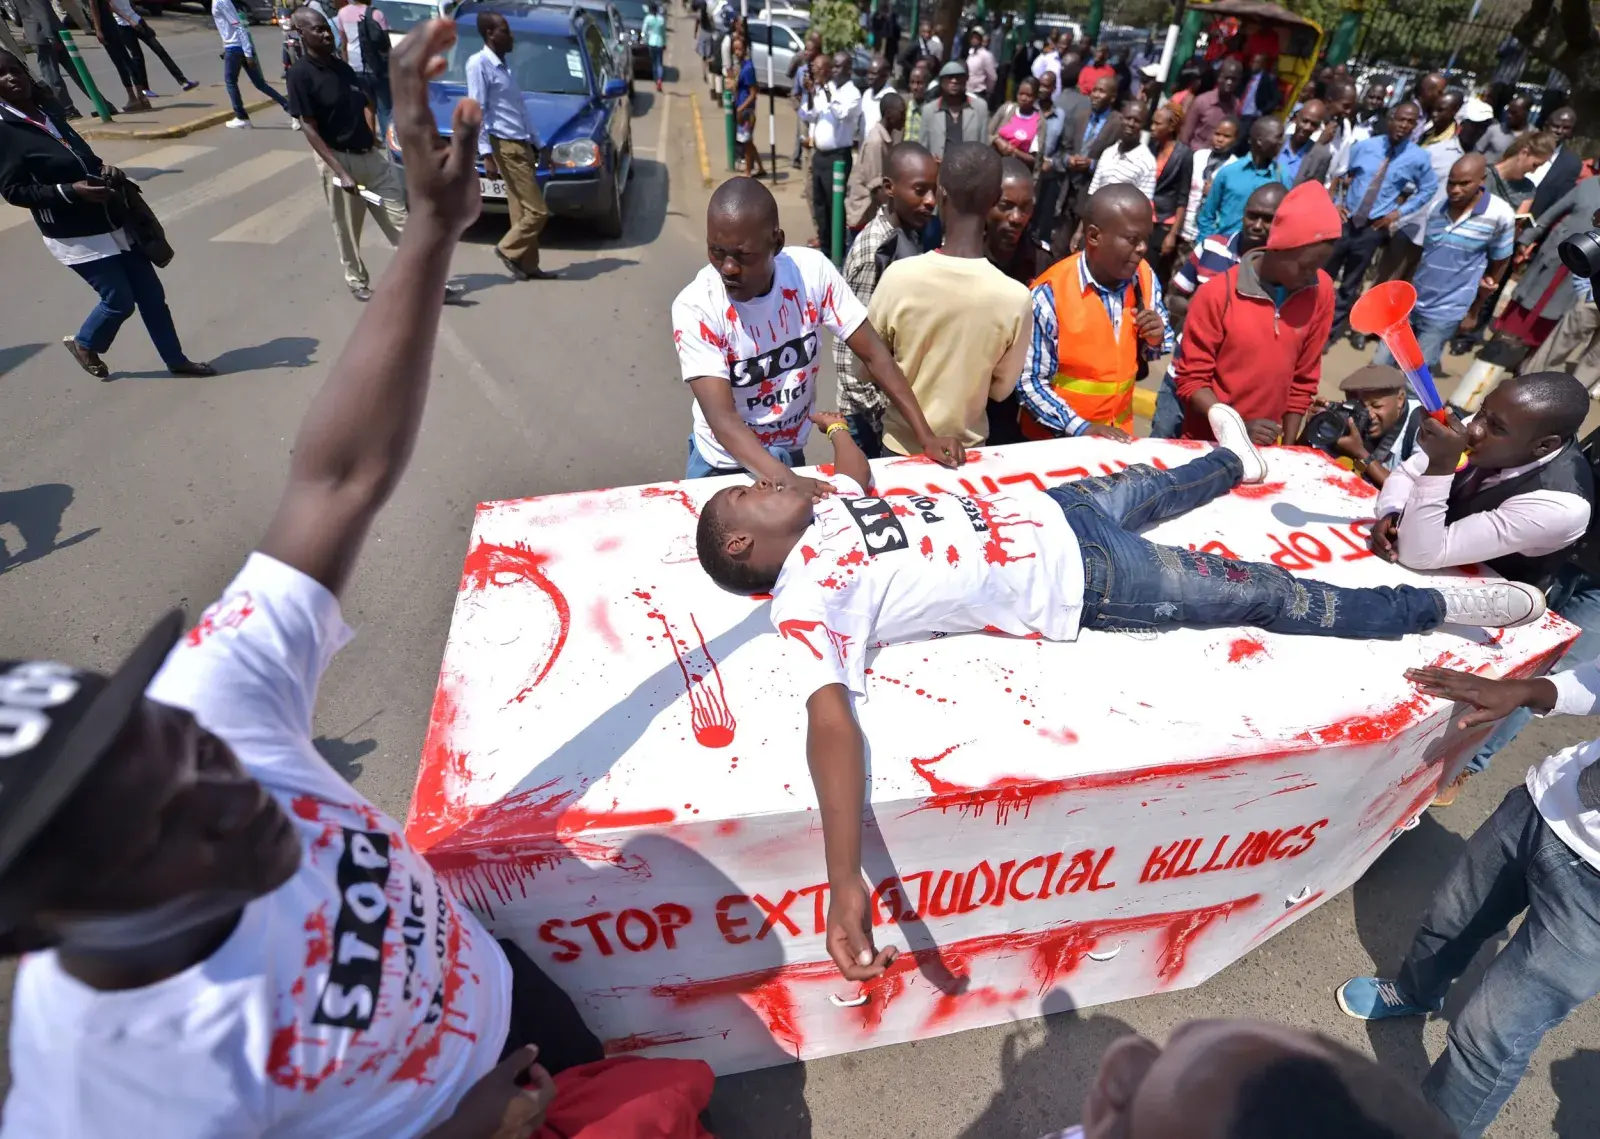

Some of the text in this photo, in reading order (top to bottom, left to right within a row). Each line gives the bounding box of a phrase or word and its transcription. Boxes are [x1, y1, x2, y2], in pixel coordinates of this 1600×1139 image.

[734, 336, 818, 386] STOP
[746, 384, 807, 411] POLICE
[852, 496, 903, 550] STO
[322, 833, 389, 1020] STOP
[403, 874, 426, 1001] POLICE
[538, 902, 693, 963] STOP
[715, 846, 1116, 945] EXTAJUDICIAL
